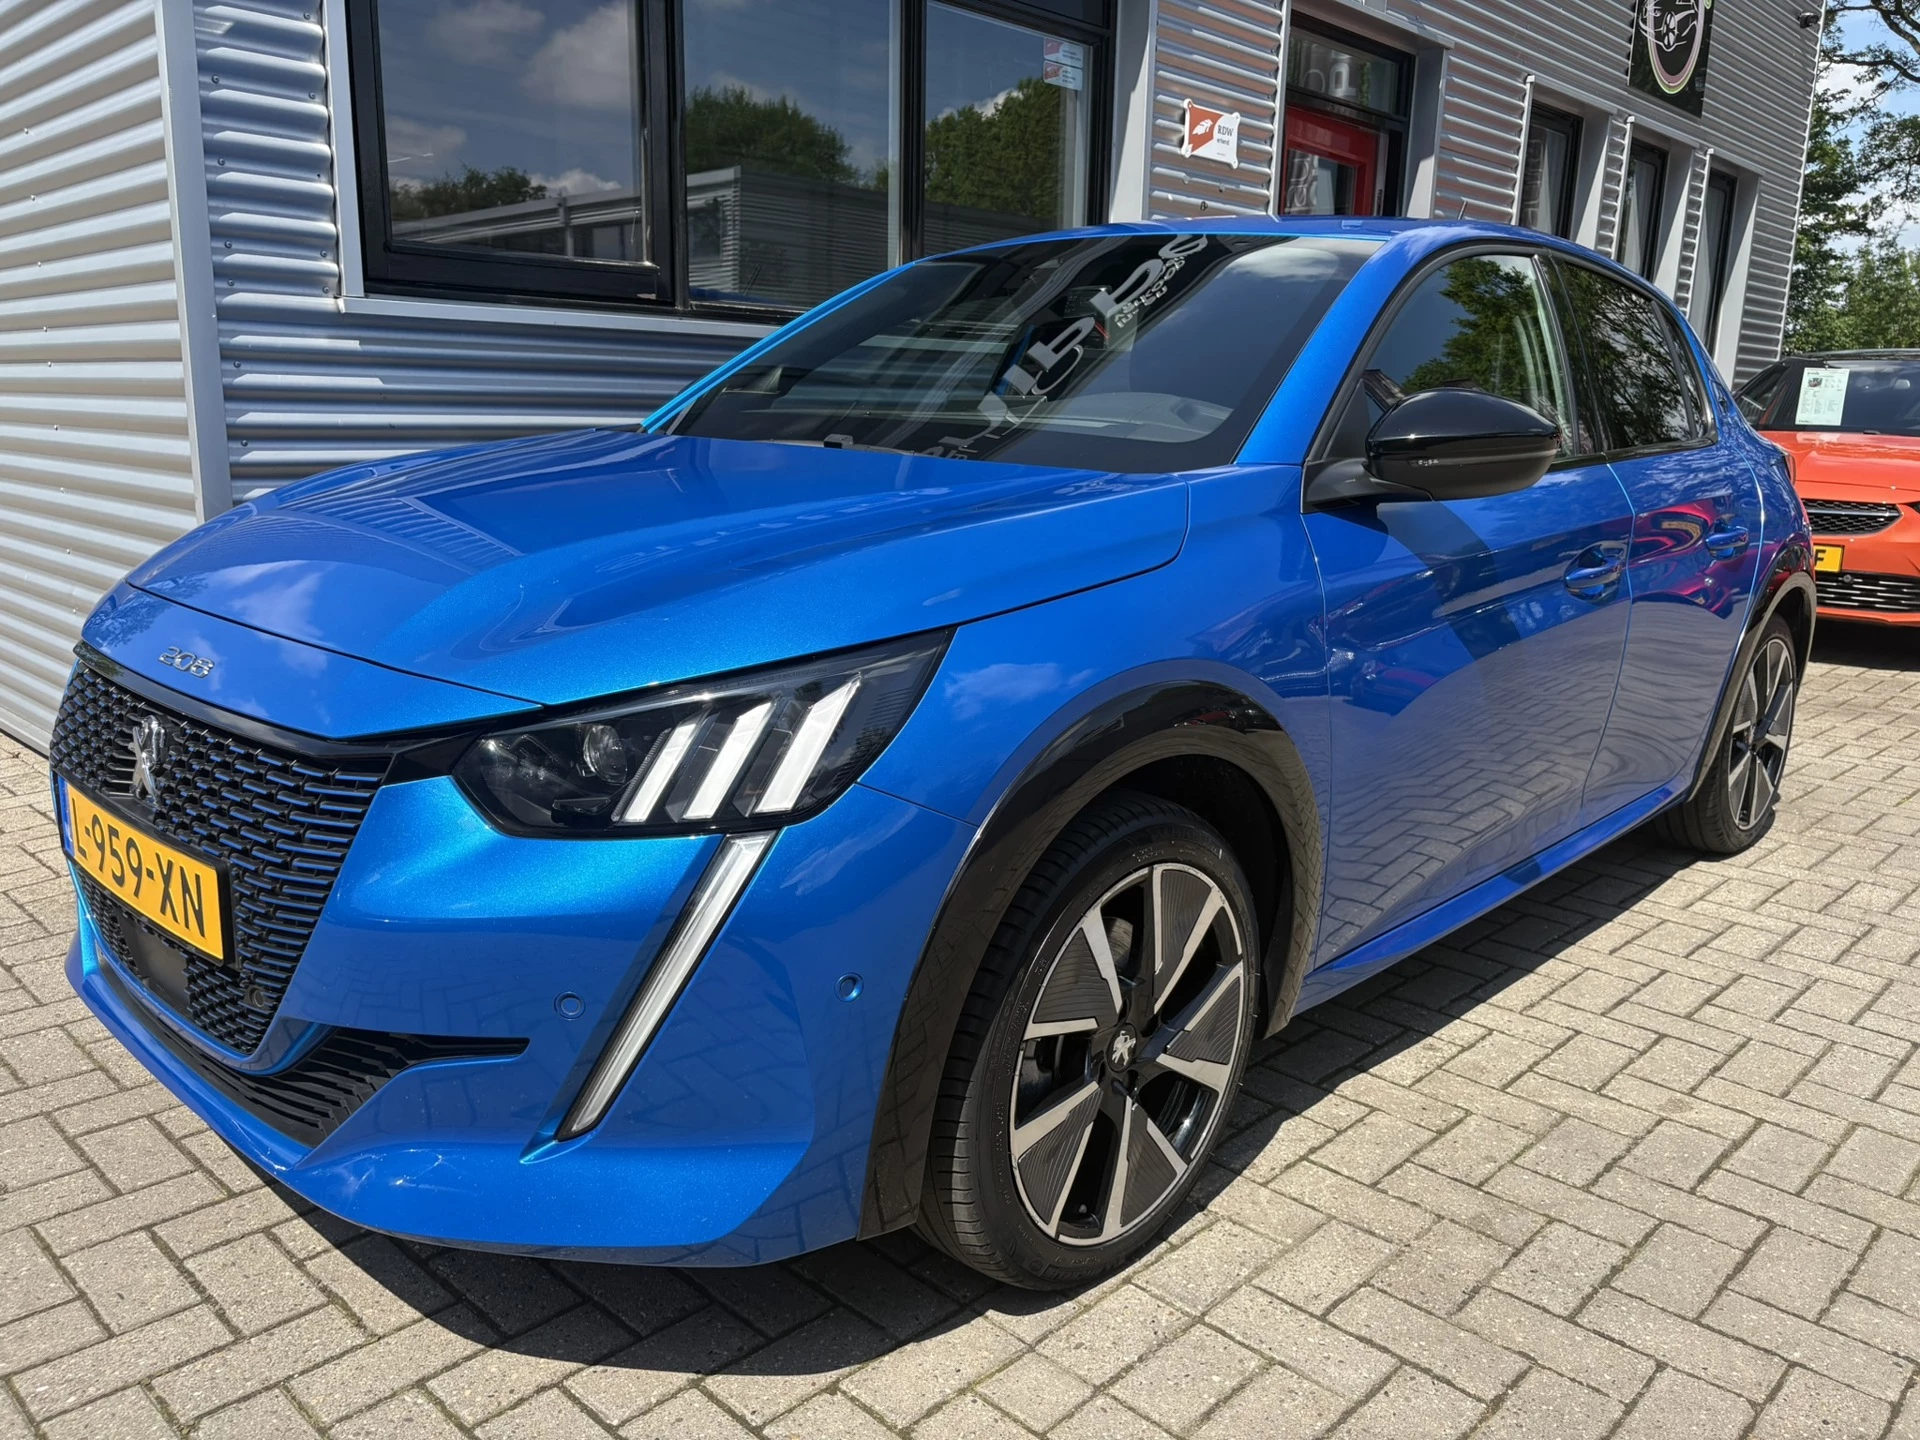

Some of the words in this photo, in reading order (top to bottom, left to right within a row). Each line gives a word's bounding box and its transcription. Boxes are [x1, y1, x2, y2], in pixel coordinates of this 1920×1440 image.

[1217, 124, 1234, 137] RDW
[158, 645, 215, 678] 208
[71, 796, 206, 939] L-959-XN
